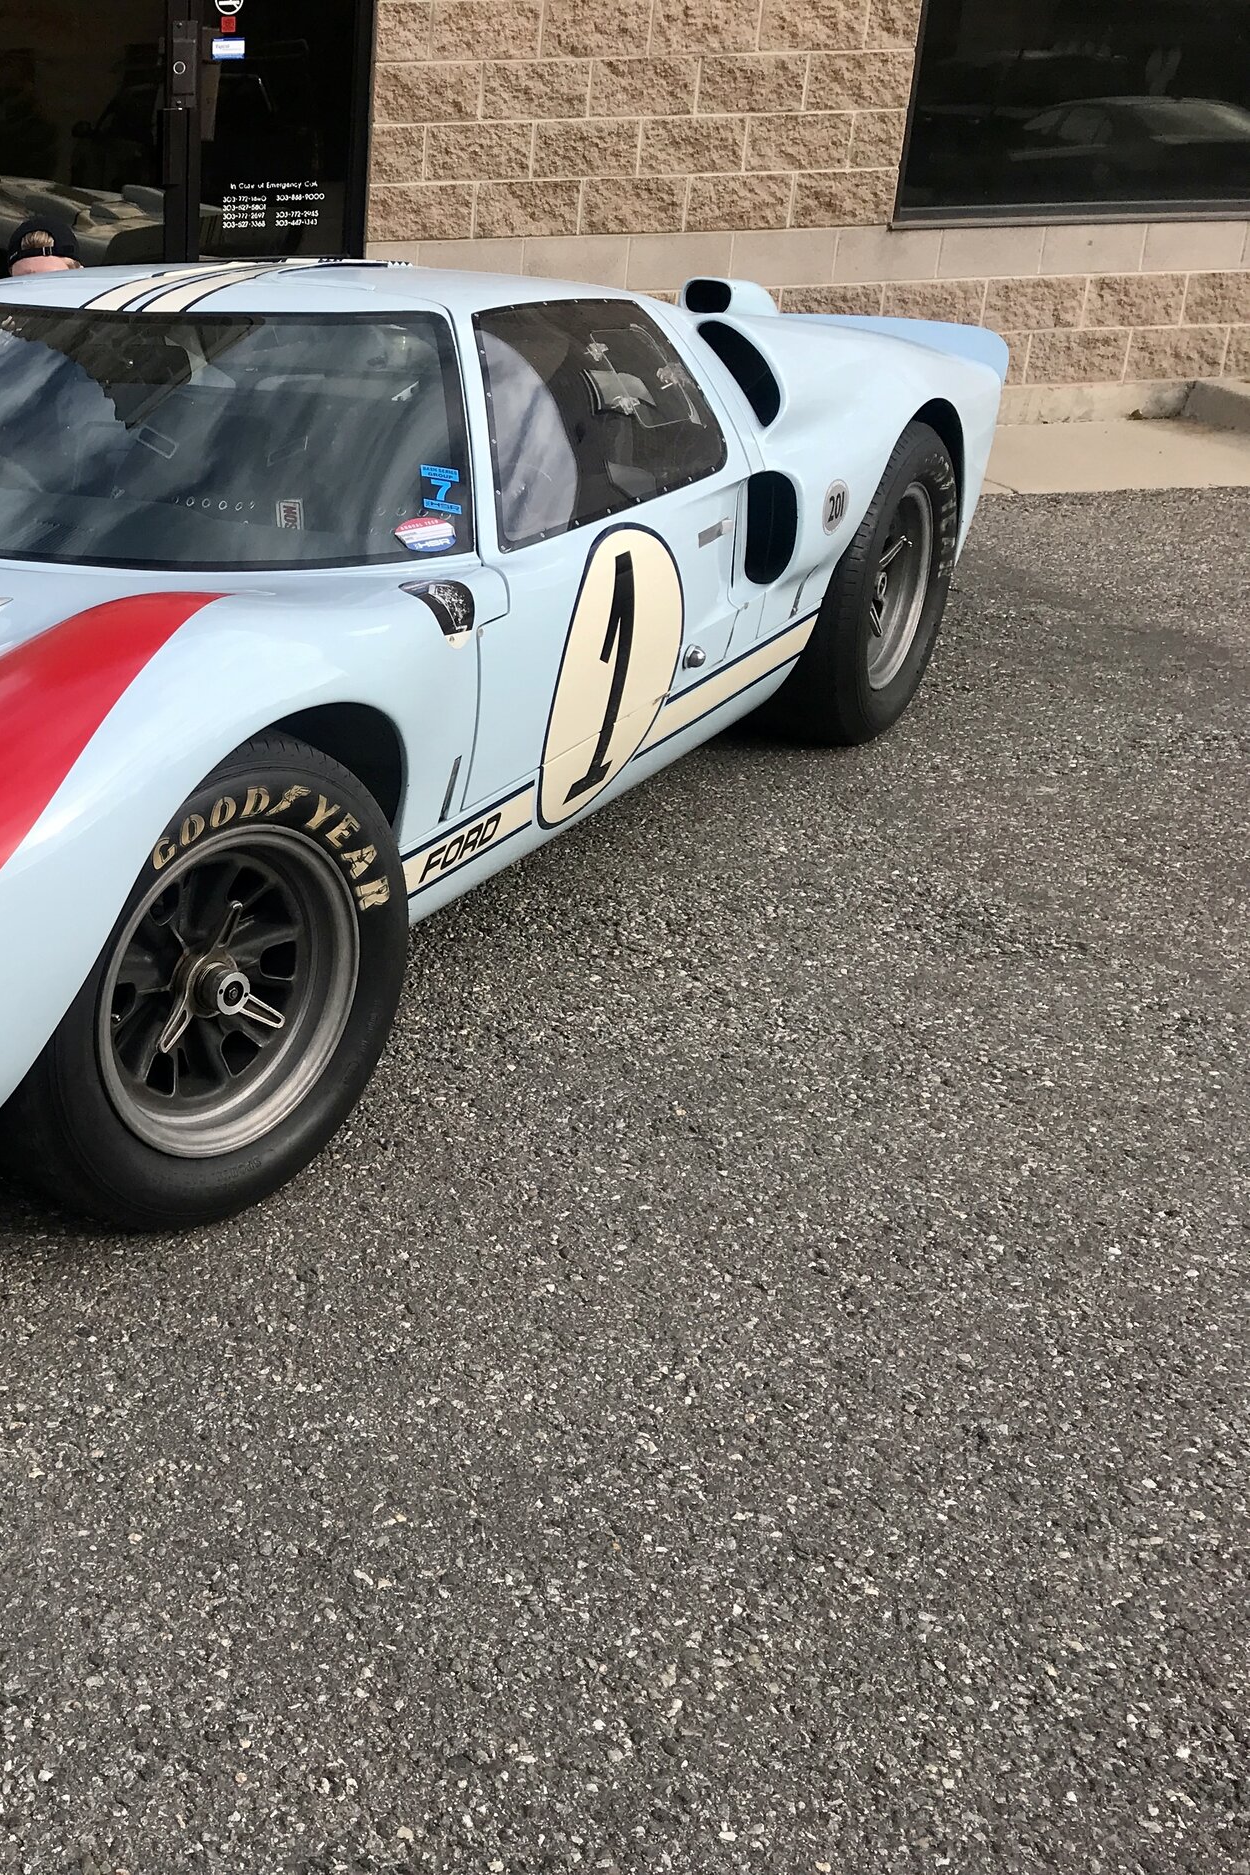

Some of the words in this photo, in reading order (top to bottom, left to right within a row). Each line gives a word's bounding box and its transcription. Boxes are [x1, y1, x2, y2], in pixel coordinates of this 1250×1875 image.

[266, 181, 302, 190] Emergency
[427, 471, 454, 480] GROUP
[438, 468, 458, 476] SERIES
[430, 478, 452, 501] 7
[430, 502, 460, 511] HSR
[827, 491, 845, 522] 201
[400, 523, 423, 531] ANNUAL
[418, 538, 451, 549] HSR
[562, 551, 635, 805] 1
[152, 786, 270, 870] GOOD
[305, 794, 391, 911] YEAR
[418, 812, 502, 884] FORD
